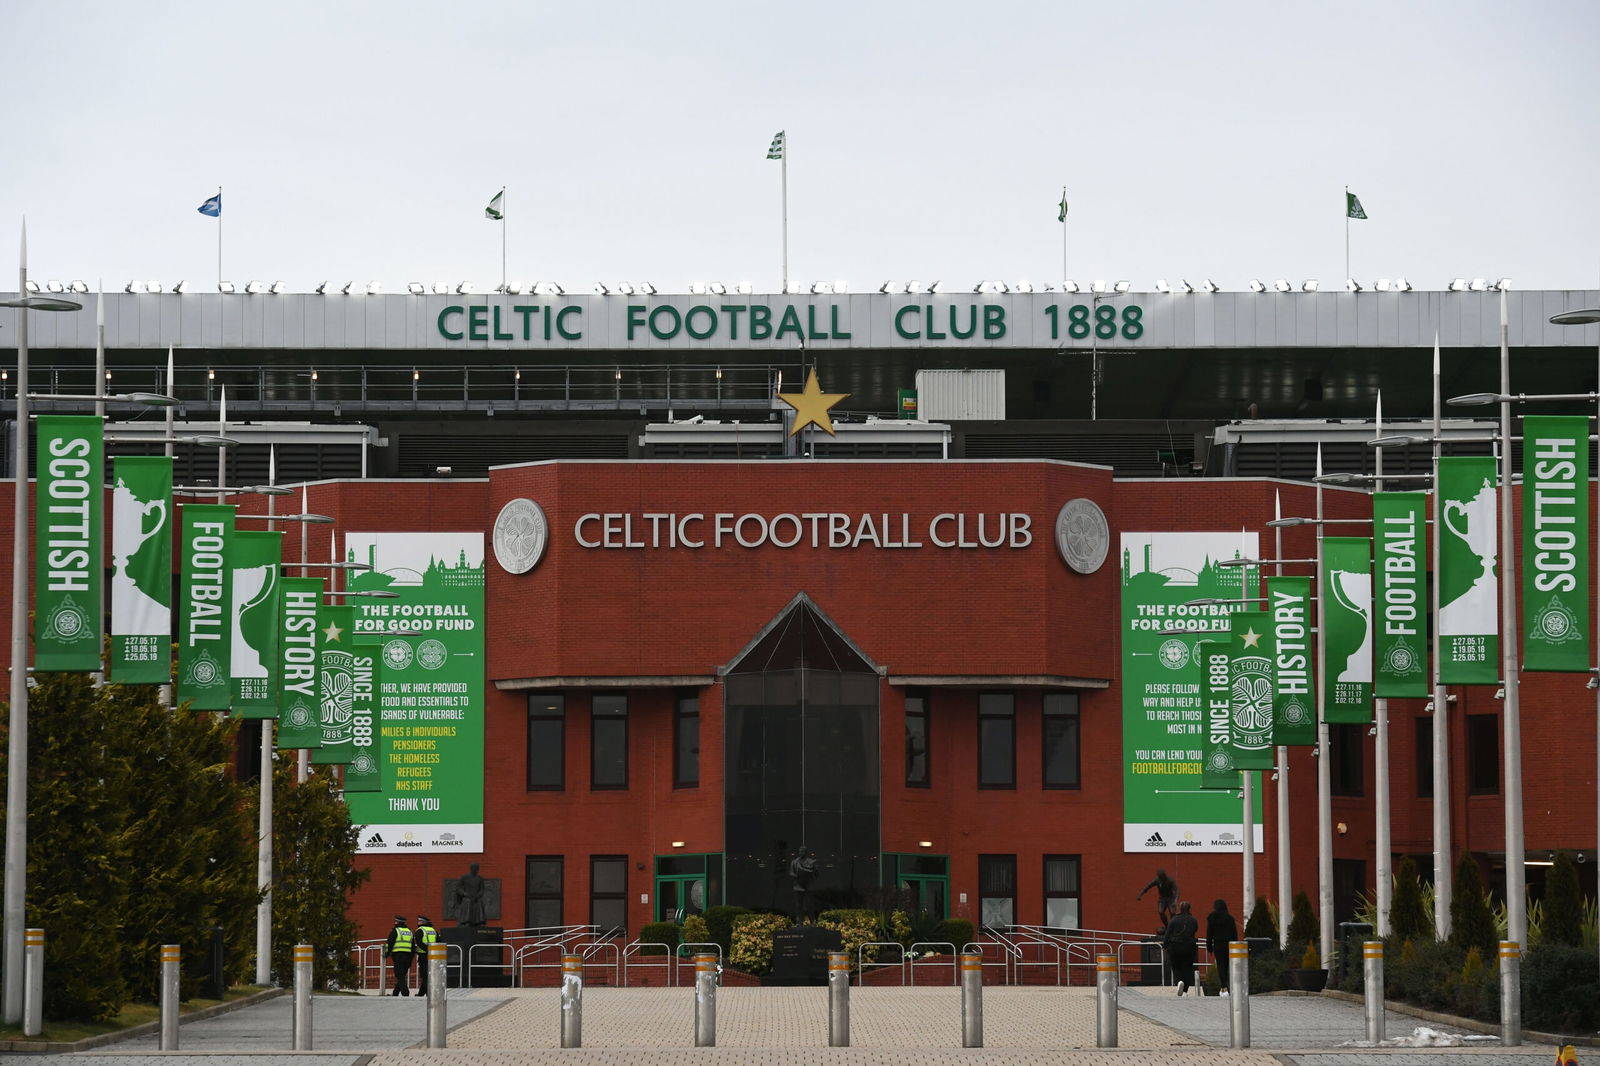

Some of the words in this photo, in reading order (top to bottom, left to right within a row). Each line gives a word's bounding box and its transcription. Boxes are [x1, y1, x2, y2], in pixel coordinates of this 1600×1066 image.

[437, 305, 582, 340] CELTIC
[627, 304, 852, 340] FOOTBALL
[895, 304, 1006, 339] CLUB
[1045, 304, 1144, 339] 1888
[48, 438, 90, 591] SCOTTISH
[1534, 438, 1576, 592] SCOTTISH
[574, 513, 704, 548] CELTIC
[715, 513, 922, 548] FOOTBALL
[929, 513, 1033, 548] CLUB
[1384, 510, 1417, 635] FOOTBALL
[190, 521, 224, 647] FOOTBALL
[361, 605, 389, 616] THE
[392, 605, 468, 616] FOOTBALL
[1137, 605, 1165, 616] THE
[355, 619, 385, 631] FOR
[388, 619, 433, 631] GOOD
[436, 619, 475, 631] FUND
[1131, 619, 1161, 630] FOR
[1164, 619, 1208, 630] GOOD
[1212, 619, 1231, 630] FU
[284, 591, 317, 696] HISTORY
[1274, 591, 1308, 694] HISTORY
[1458, 637, 1485, 645] 27.05.17
[322, 656, 353, 669] FOOTB
[1209, 654, 1229, 691] 1888
[353, 657, 373, 701] SINCE
[400, 683, 411, 693] WE
[413, 683, 431, 693] HAVE
[433, 683, 467, 693] PROVIDED
[1145, 684, 1171, 694] PLEASE
[1172, 684, 1200, 694] FOLLOW
[381, 696, 400, 706] FOOD
[402, 696, 416, 706] AND
[418, 696, 458, 706] ESSENTIALS
[460, 696, 469, 706] TO
[1143, 697, 1159, 707] WAY
[1160, 697, 1175, 707] AND
[1176, 697, 1194, 707] HELP
[409, 710, 418, 720] OF
[420, 710, 465, 720] VULNERABLE:
[1146, 710, 1156, 720] TO
[1157, 710, 1180, 720] REACH
[1210, 699, 1230, 744] SINCE
[353, 708, 373, 747] 1888
[381, 726, 404, 737] MILIES
[406, 726, 411, 737] &
[413, 726, 457, 737] INDIVIDUALS
[1167, 724, 1186, 734] MOST
[1188, 724, 1195, 734] IN
[322, 730, 342, 739] 1888
[1244, 735, 1263, 744] 1888
[393, 740, 436, 750] PENSIONERS
[389, 754, 401, 764] THE
[403, 754, 440, 764] HOMELESS
[1135, 750, 1150, 760] YOU
[1151, 750, 1165, 760] CAN
[1167, 750, 1185, 760] LEND
[397, 767, 432, 777] REFUGEES
[396, 781, 410, 791] NHS
[412, 781, 433, 791] STAFF
[389, 798, 419, 811] THANK
[421, 798, 440, 811] YOU
[1176, 840, 1202, 848] dafabet
